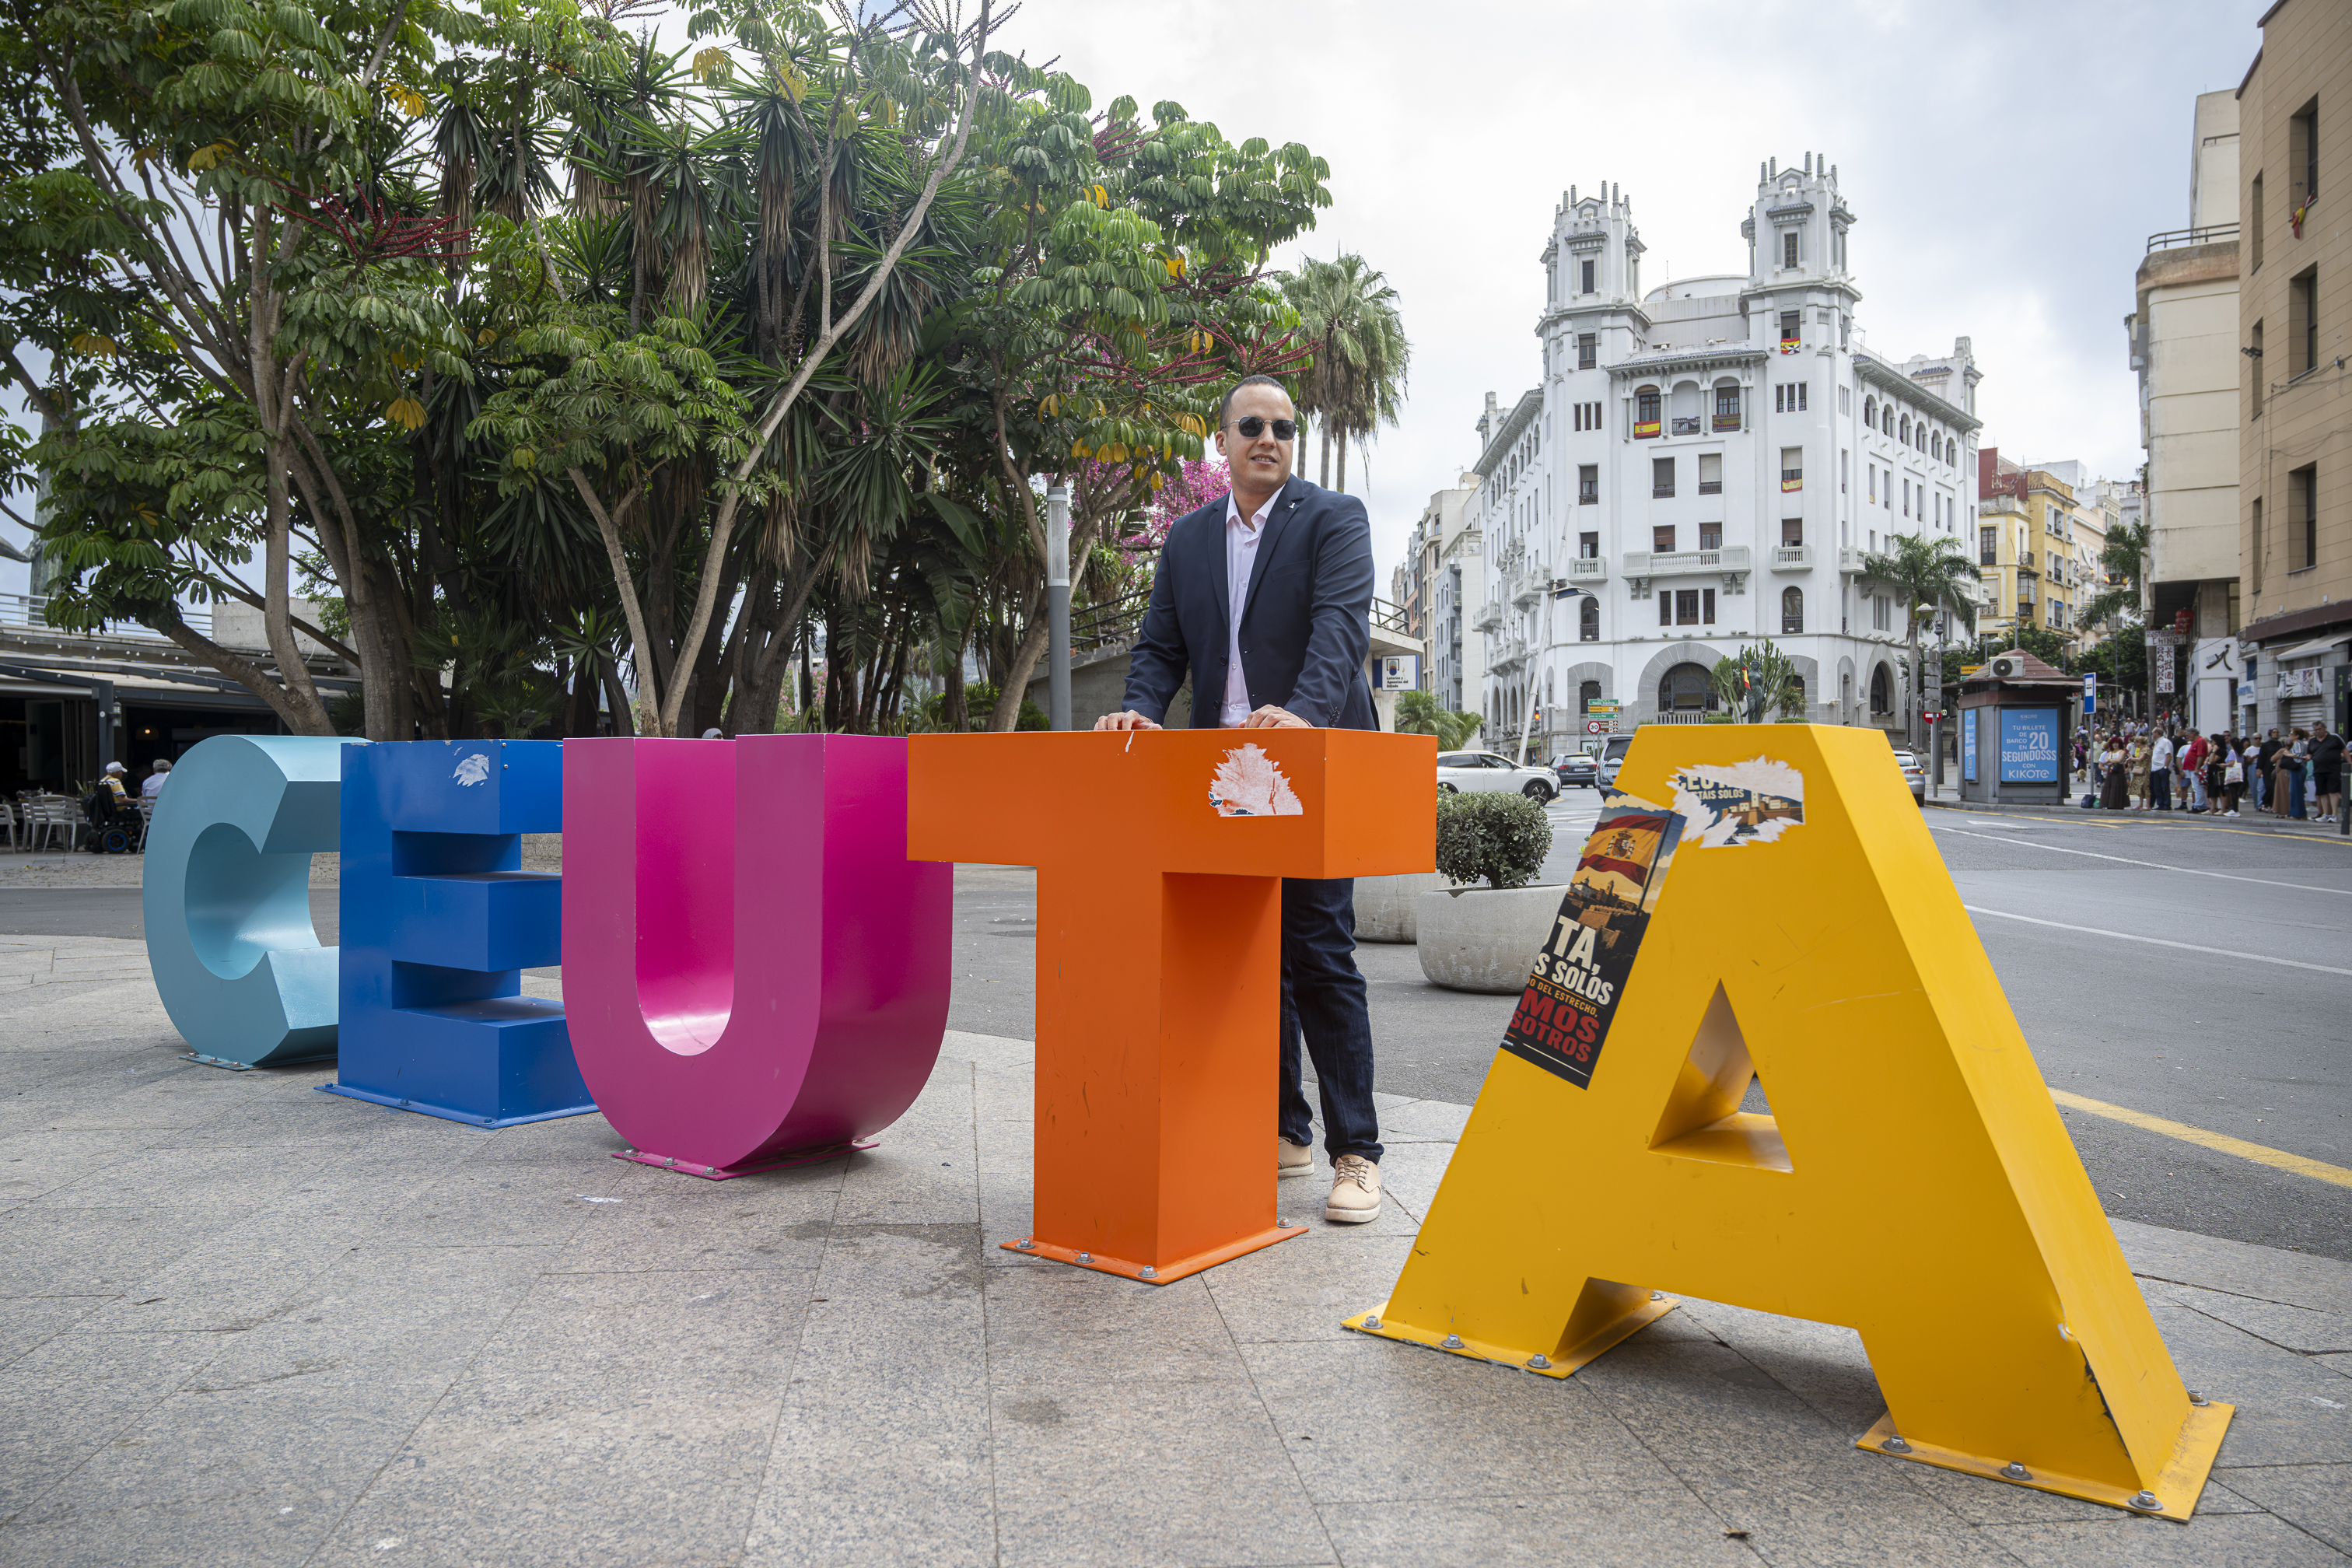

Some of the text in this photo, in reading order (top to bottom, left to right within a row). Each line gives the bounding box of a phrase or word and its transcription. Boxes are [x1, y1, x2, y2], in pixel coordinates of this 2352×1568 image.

[2002, 749, 2056, 762] SEGUNDOSSS
[2029, 731, 2049, 750] 20
[1717, 789, 1745, 800] SOLOS
[1543, 914, 1601, 976] TA,
[1537, 982, 1552, 996] DEL
[1554, 990, 1598, 1017] ESTRECHO,
[1552, 961, 1614, 1006] SOLOS
[144, 723, 2193, 1517] CEUTA
